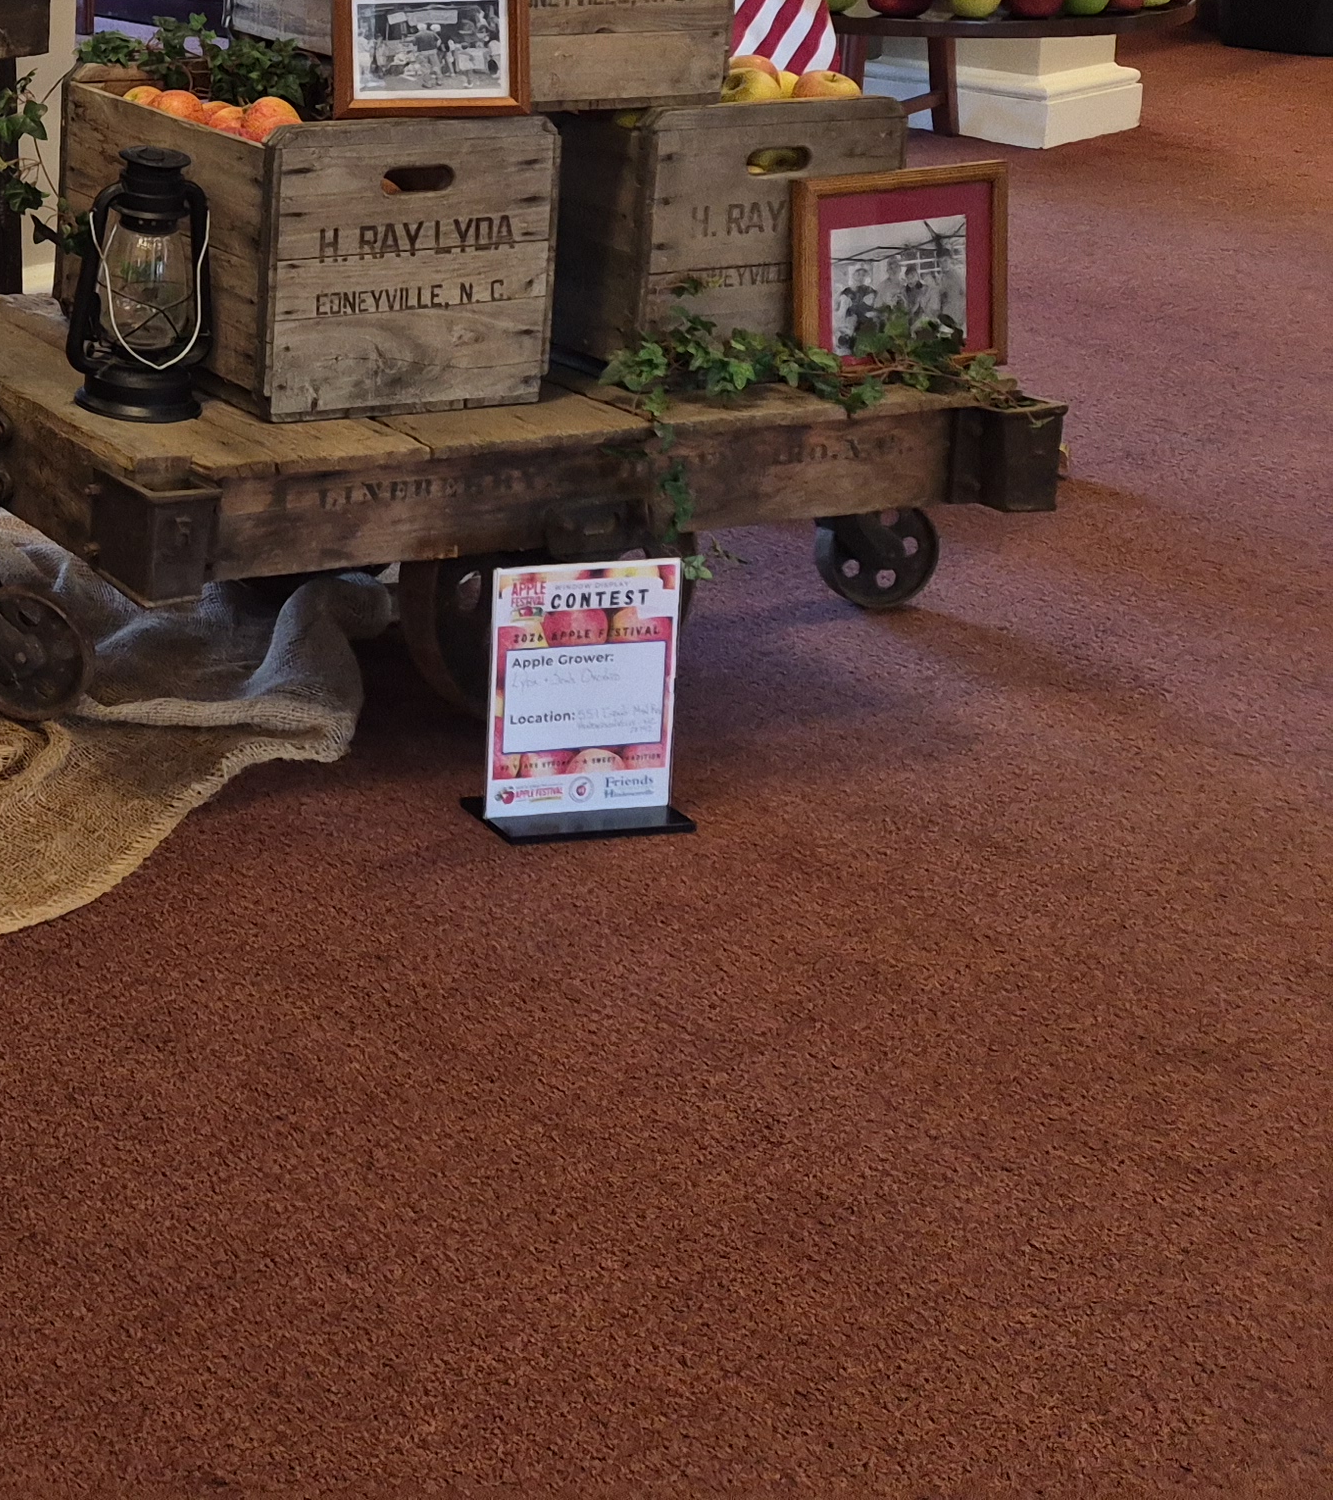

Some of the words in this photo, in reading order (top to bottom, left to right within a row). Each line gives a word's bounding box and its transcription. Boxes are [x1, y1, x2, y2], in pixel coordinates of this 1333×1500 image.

[727, 200, 787, 236] RAY
[319, 227, 348, 264] H.
[359, 220, 424, 261] RAY
[434, 214, 516, 255] LYDA
[459, 281, 481, 304] N.
[490, 279, 512, 301] C.
[511, 580, 546, 596] APPLE
[550, 588, 650, 610] CONTEST
[550, 628, 591, 642] APPLE
[598, 624, 661, 639] FESTIVAL
[512, 656, 554, 670] Apple
[558, 652, 614, 666] Grower:
[509, 709, 576, 725] Location:
[604, 775, 654, 789] Friends
